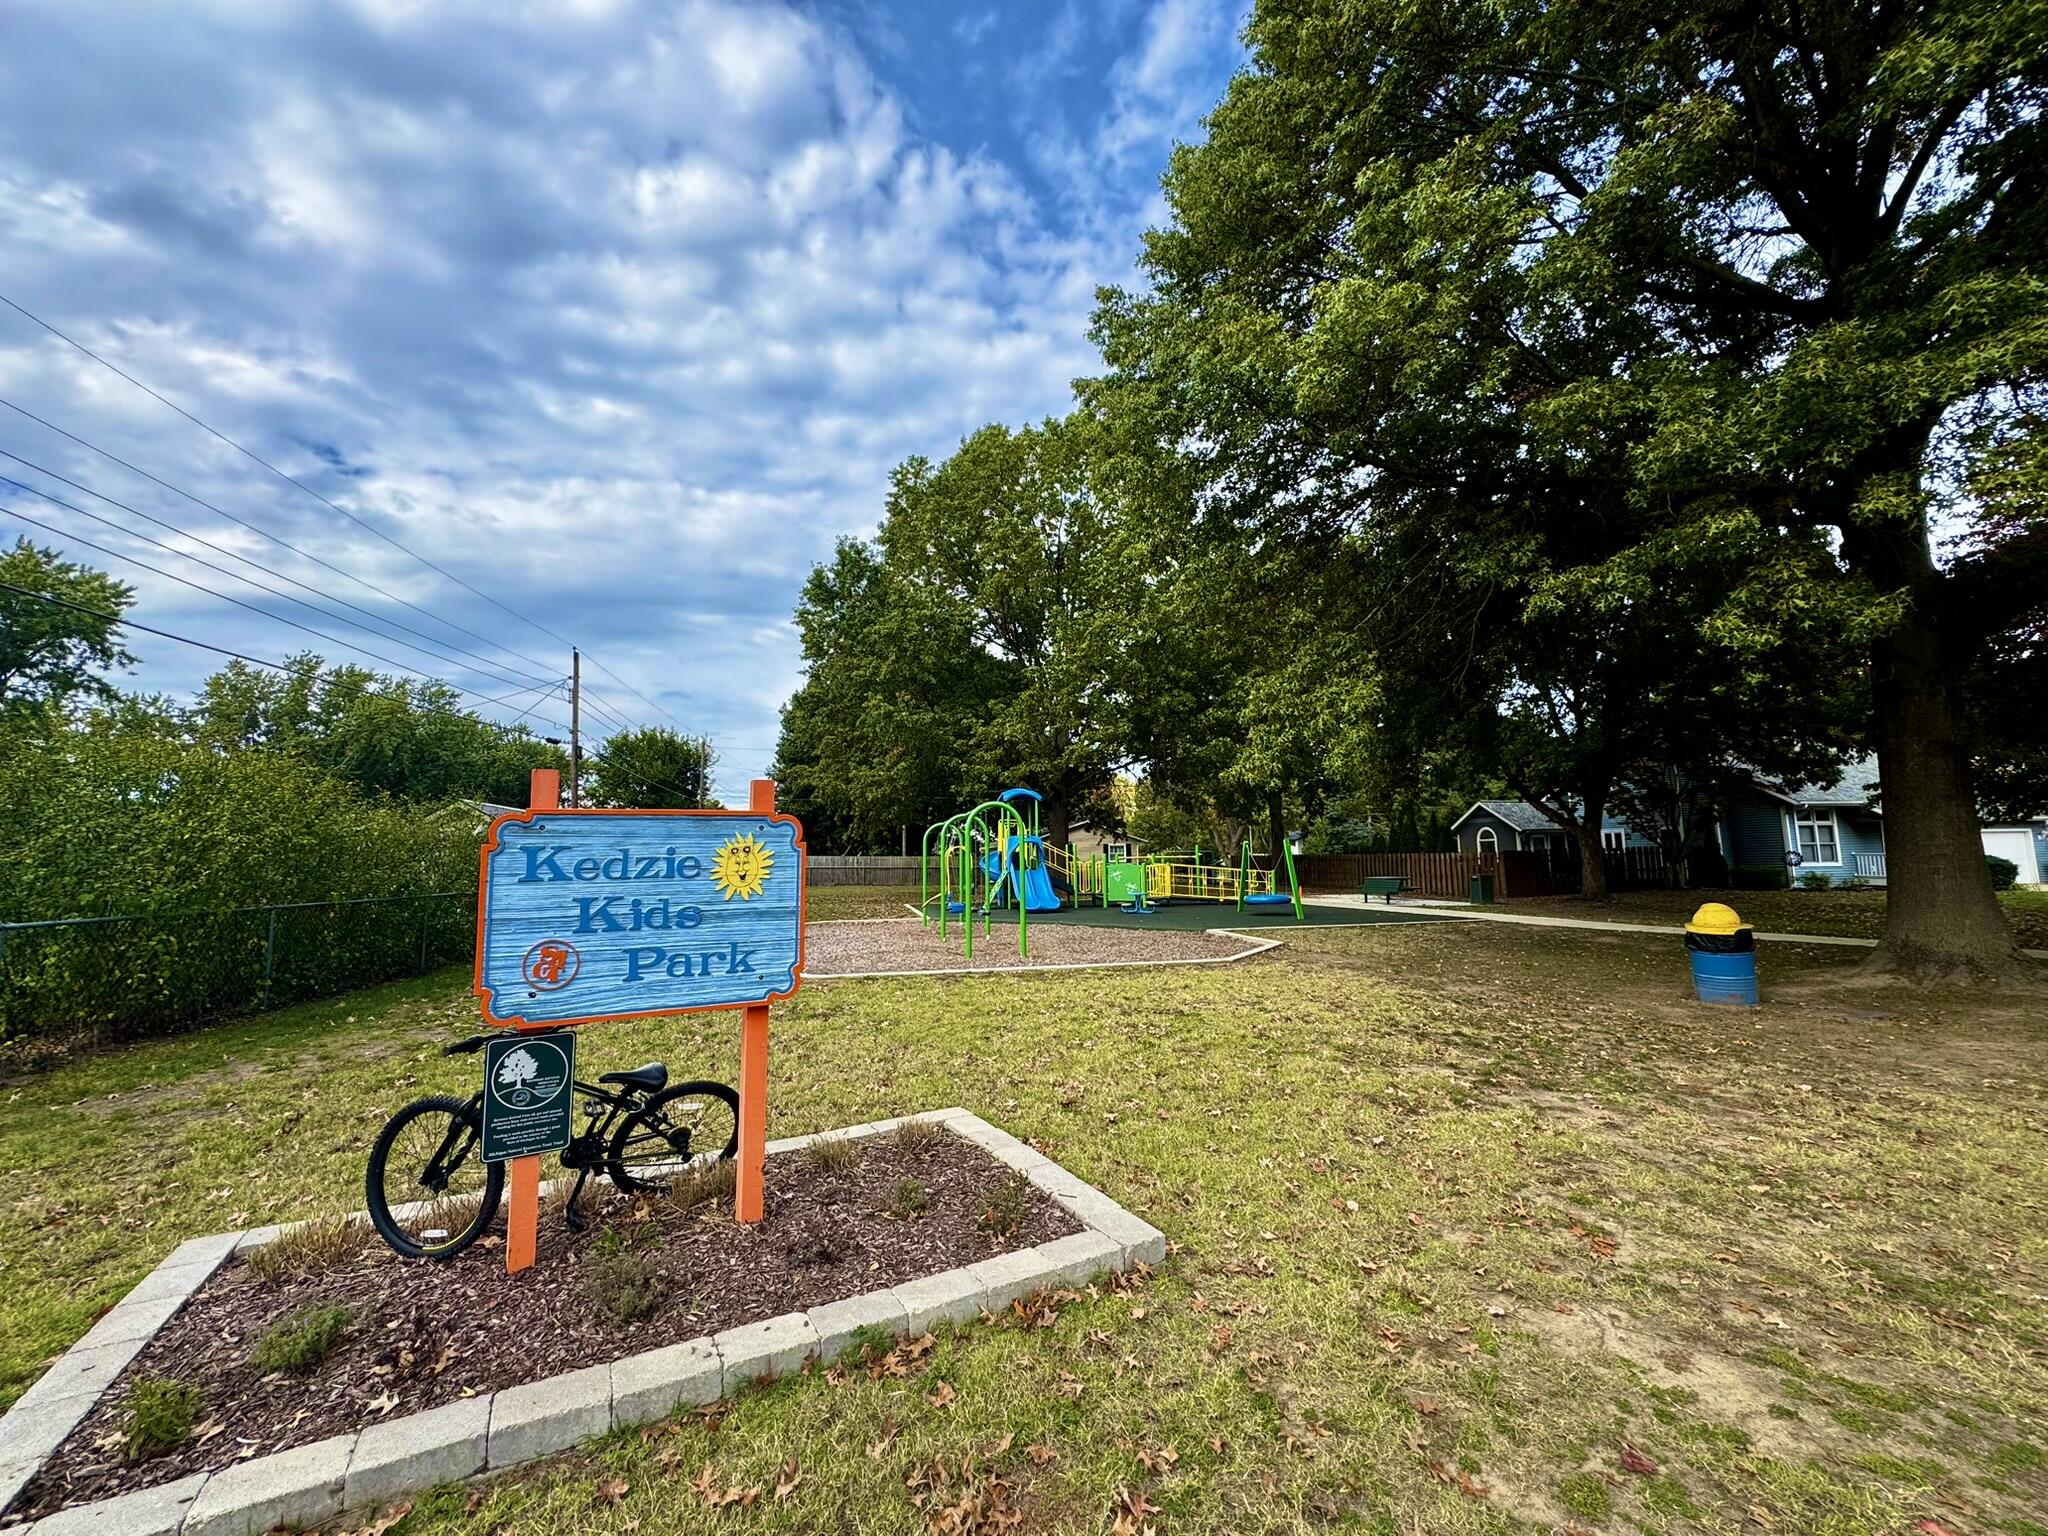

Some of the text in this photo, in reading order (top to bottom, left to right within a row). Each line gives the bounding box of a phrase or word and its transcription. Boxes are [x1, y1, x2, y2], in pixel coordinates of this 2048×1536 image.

[517, 845, 703, 883] Kedzie
[572, 895, 704, 934] Kids
[622, 941, 757, 983] Park
